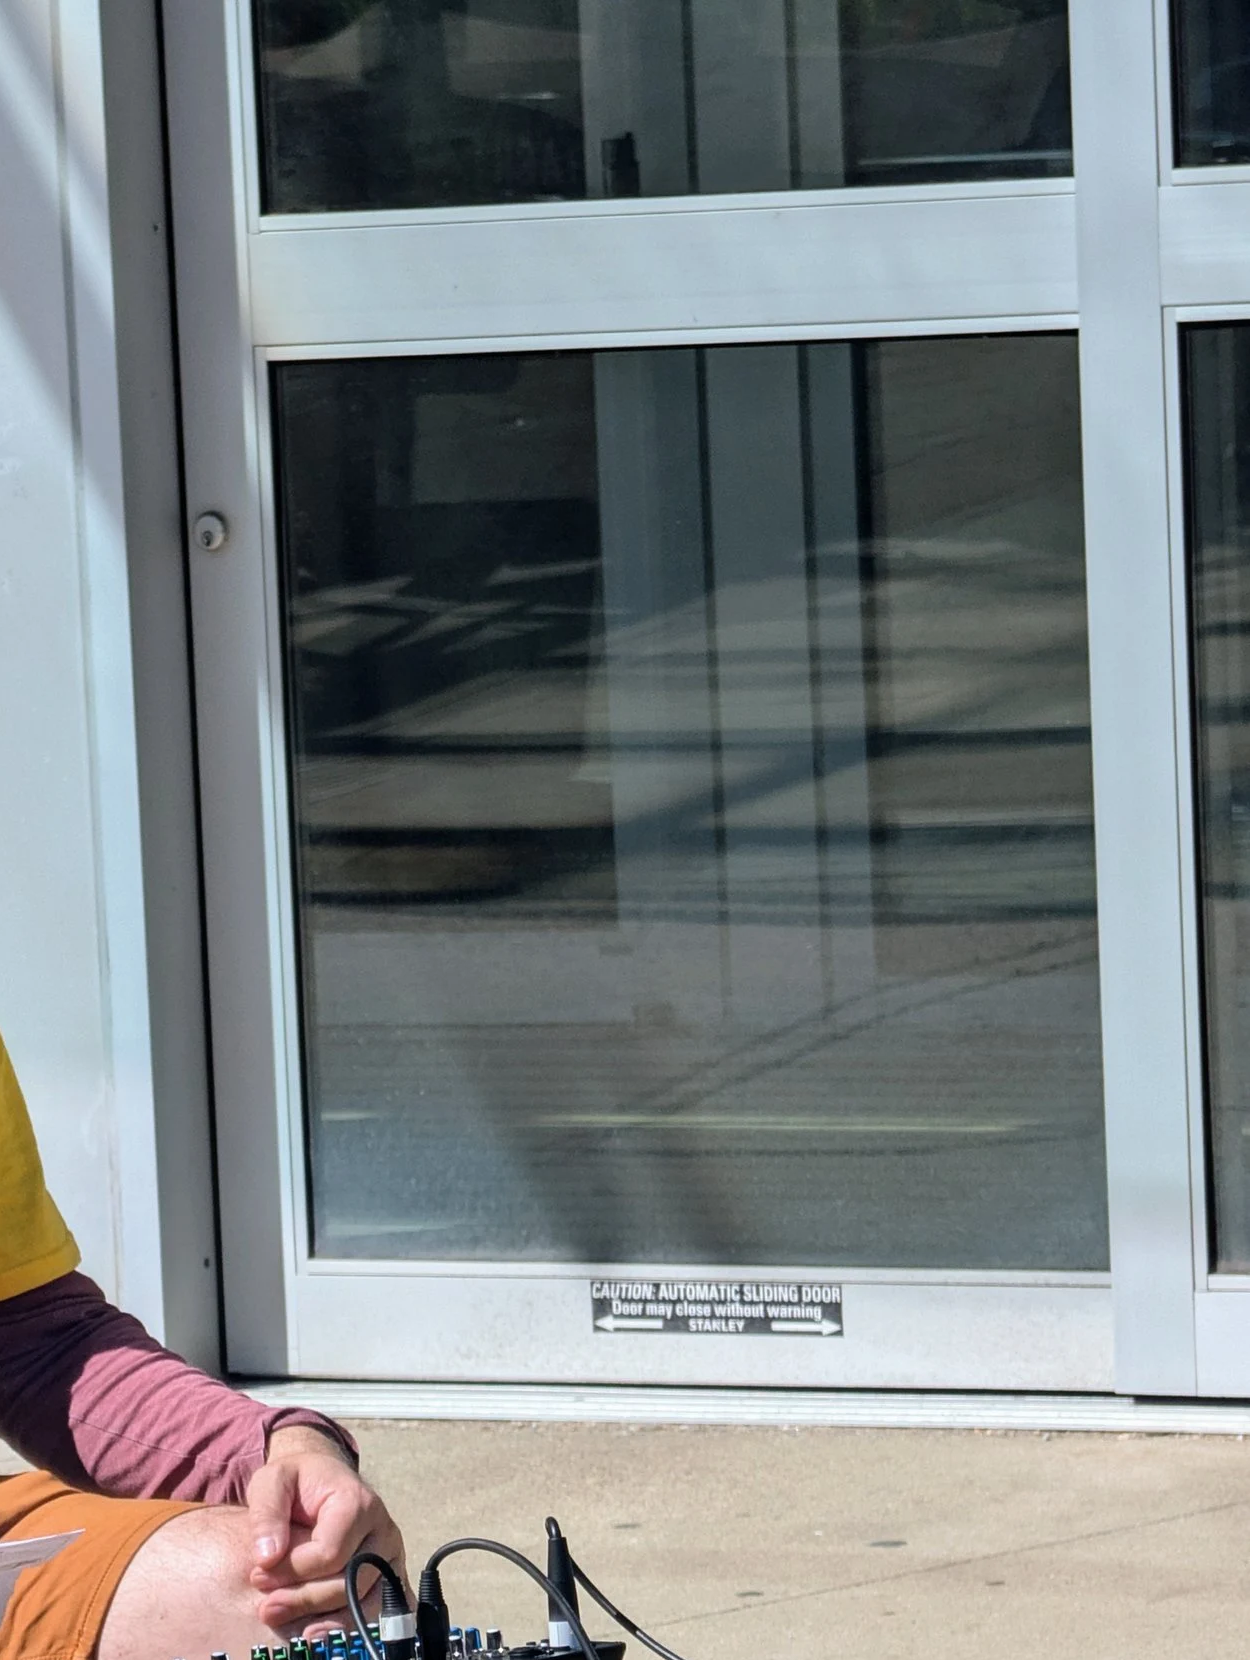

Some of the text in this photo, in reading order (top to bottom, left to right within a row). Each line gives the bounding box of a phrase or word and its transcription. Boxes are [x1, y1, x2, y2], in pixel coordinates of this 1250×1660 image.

[592, 1283, 841, 1304] CAUTION: AUTOMATIC SLIDING DOOR
[612, 1299, 822, 1321] Door may close without warning
